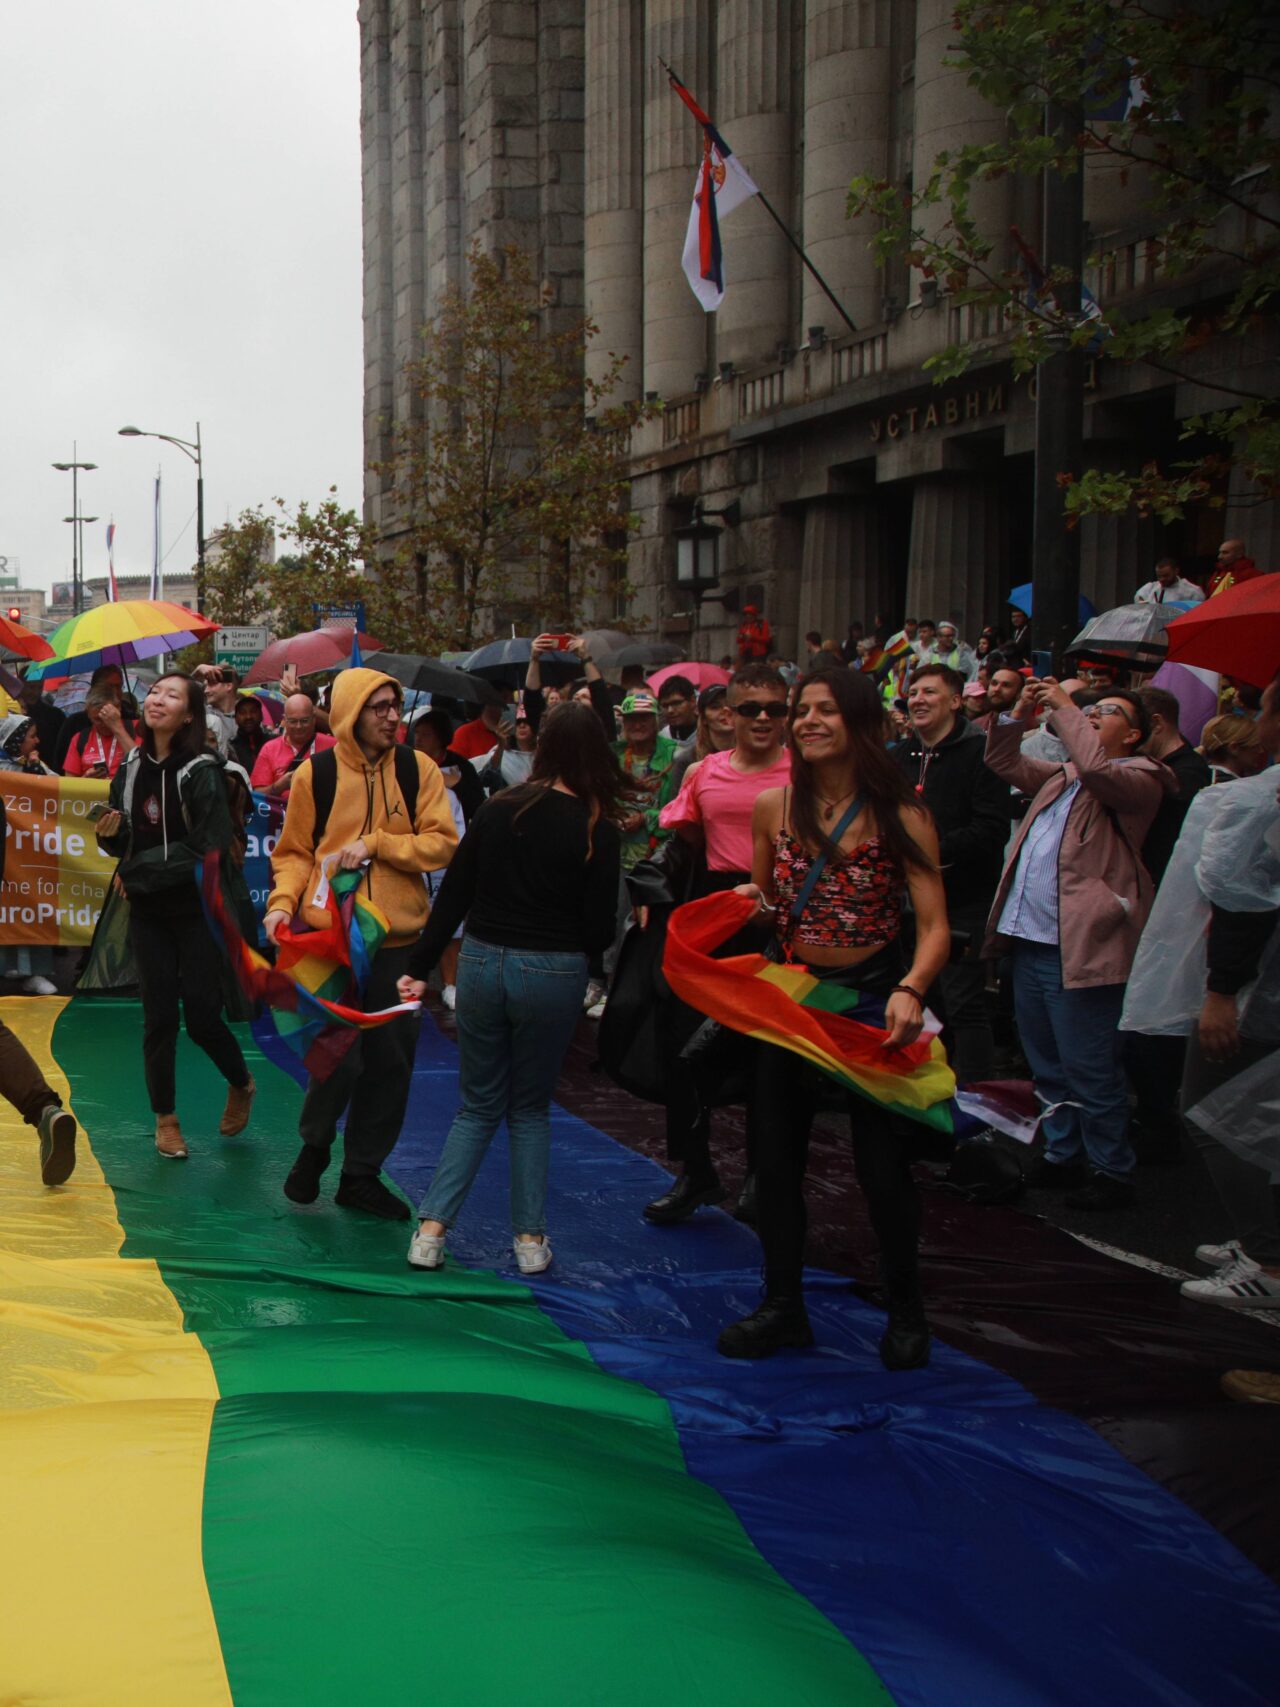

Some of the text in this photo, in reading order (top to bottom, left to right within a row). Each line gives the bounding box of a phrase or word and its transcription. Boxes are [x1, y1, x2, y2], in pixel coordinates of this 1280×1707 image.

[871, 383, 1003, 442] УСТАВНИ
[231, 631, 260, 640] Центар
[37, 877, 64, 895] for
[71, 881, 104, 898] cha
